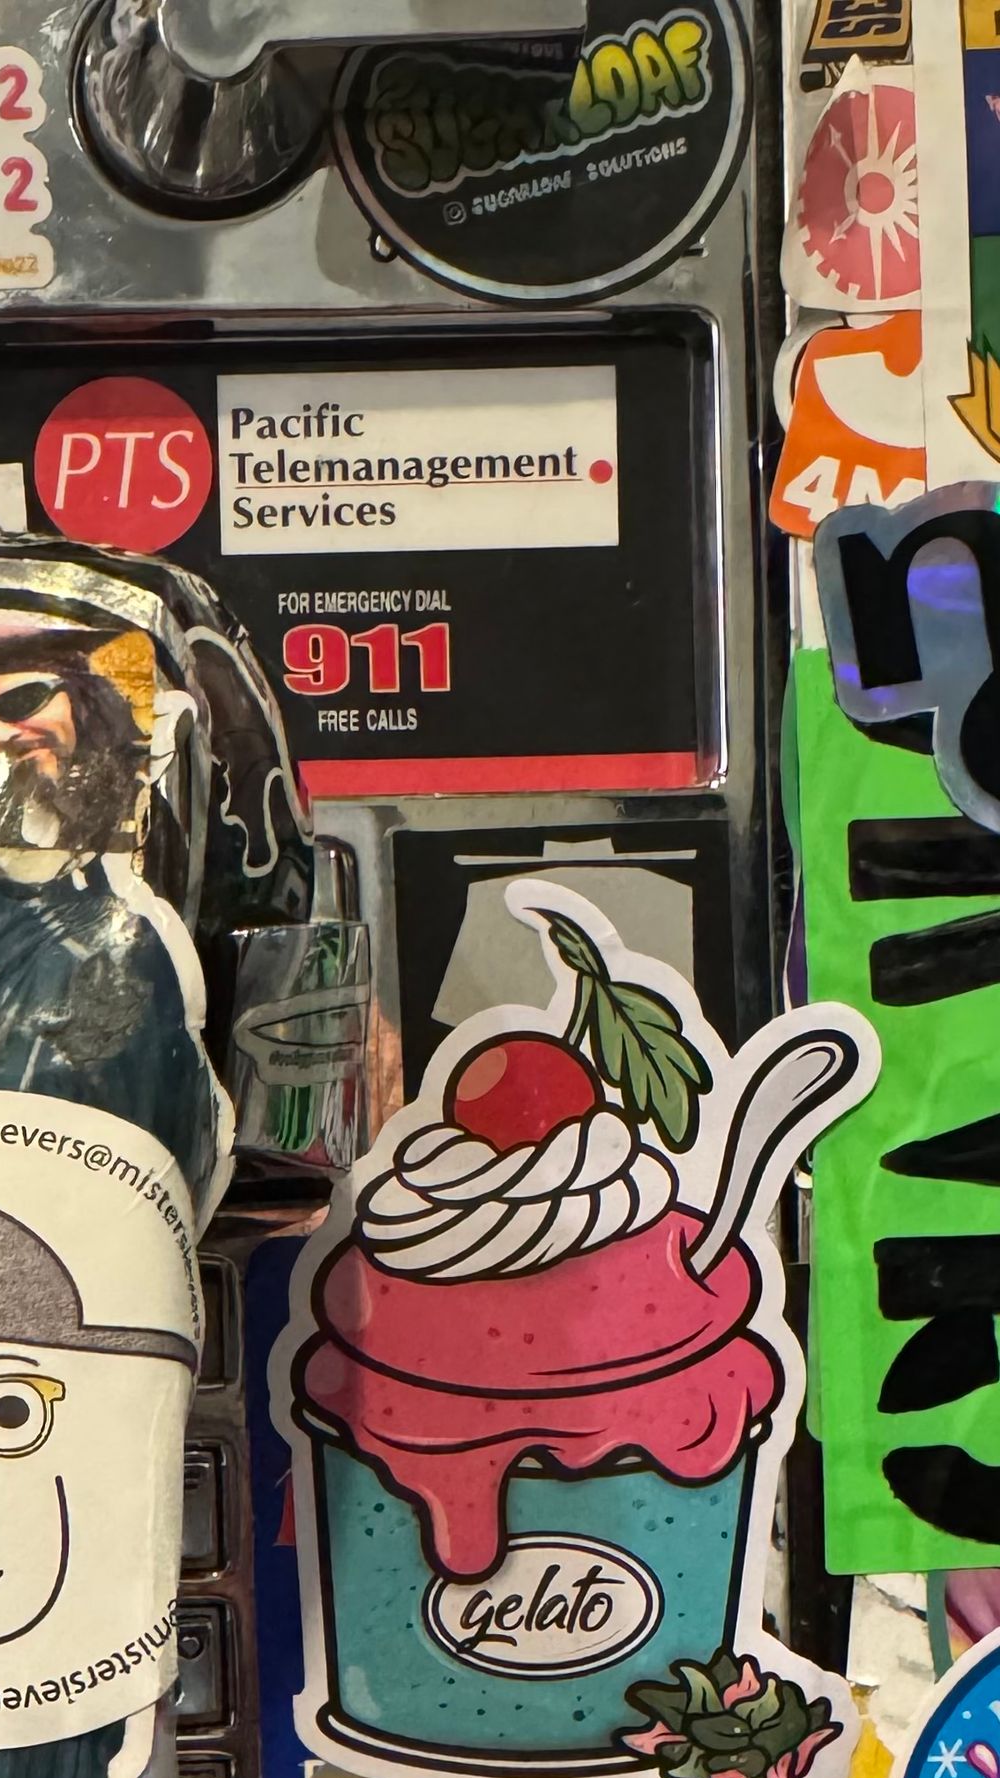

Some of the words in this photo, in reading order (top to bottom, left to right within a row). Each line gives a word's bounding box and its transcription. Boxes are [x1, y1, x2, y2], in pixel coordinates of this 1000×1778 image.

[586, 137, 688, 181] SOLUTIONS
[230, 402, 364, 440] Pacific
[53, 429, 194, 511] PTS
[230, 446, 577, 487] Telemanagement
[232, 494, 397, 531] Services
[278, 593, 311, 614] FOR
[315, 591, 413, 613] EMERGENCY
[416, 589, 451, 611] DIAL
[283, 621, 451, 695] 911
[318, 710, 360, 732] FREE
[367, 708, 418, 731] CALLS
[456, 1564, 625, 1653] gelato
